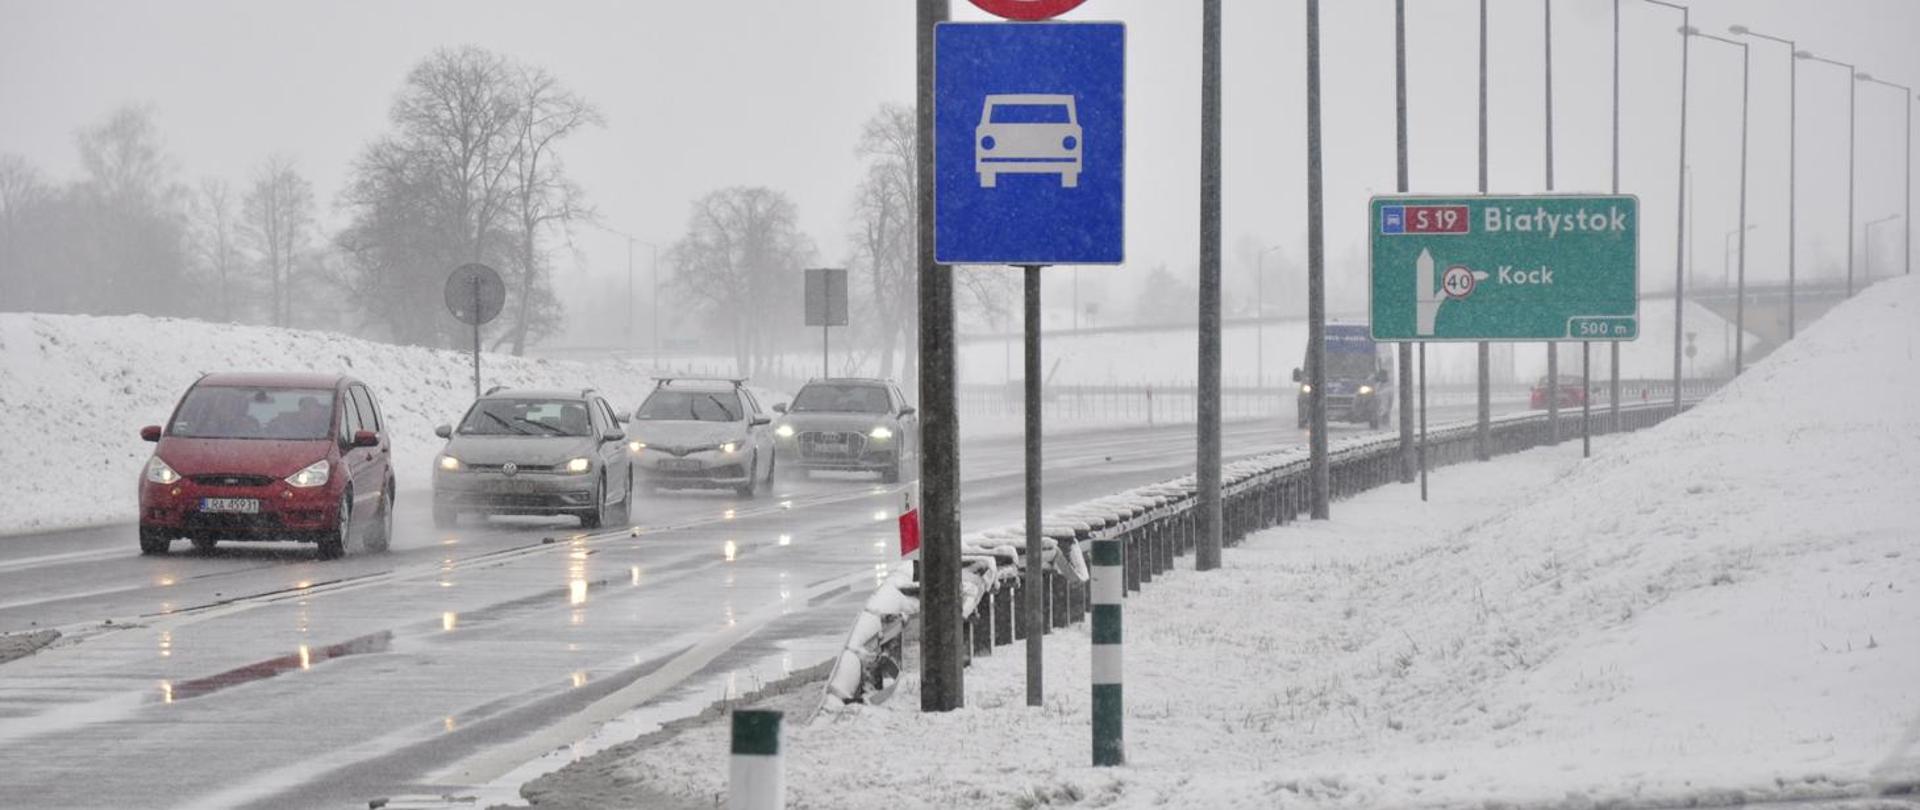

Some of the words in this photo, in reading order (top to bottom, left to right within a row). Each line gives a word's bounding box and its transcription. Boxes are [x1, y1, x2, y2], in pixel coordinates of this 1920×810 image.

[1416, 210, 1429, 229] S
[1435, 210, 1457, 229] 19
[1485, 207, 1626, 239] Białystok
[1447, 274, 1470, 290] 40
[1499, 265, 1553, 284] Kock
[1580, 321, 1608, 335] 500
[1615, 325, 1626, 335] m
